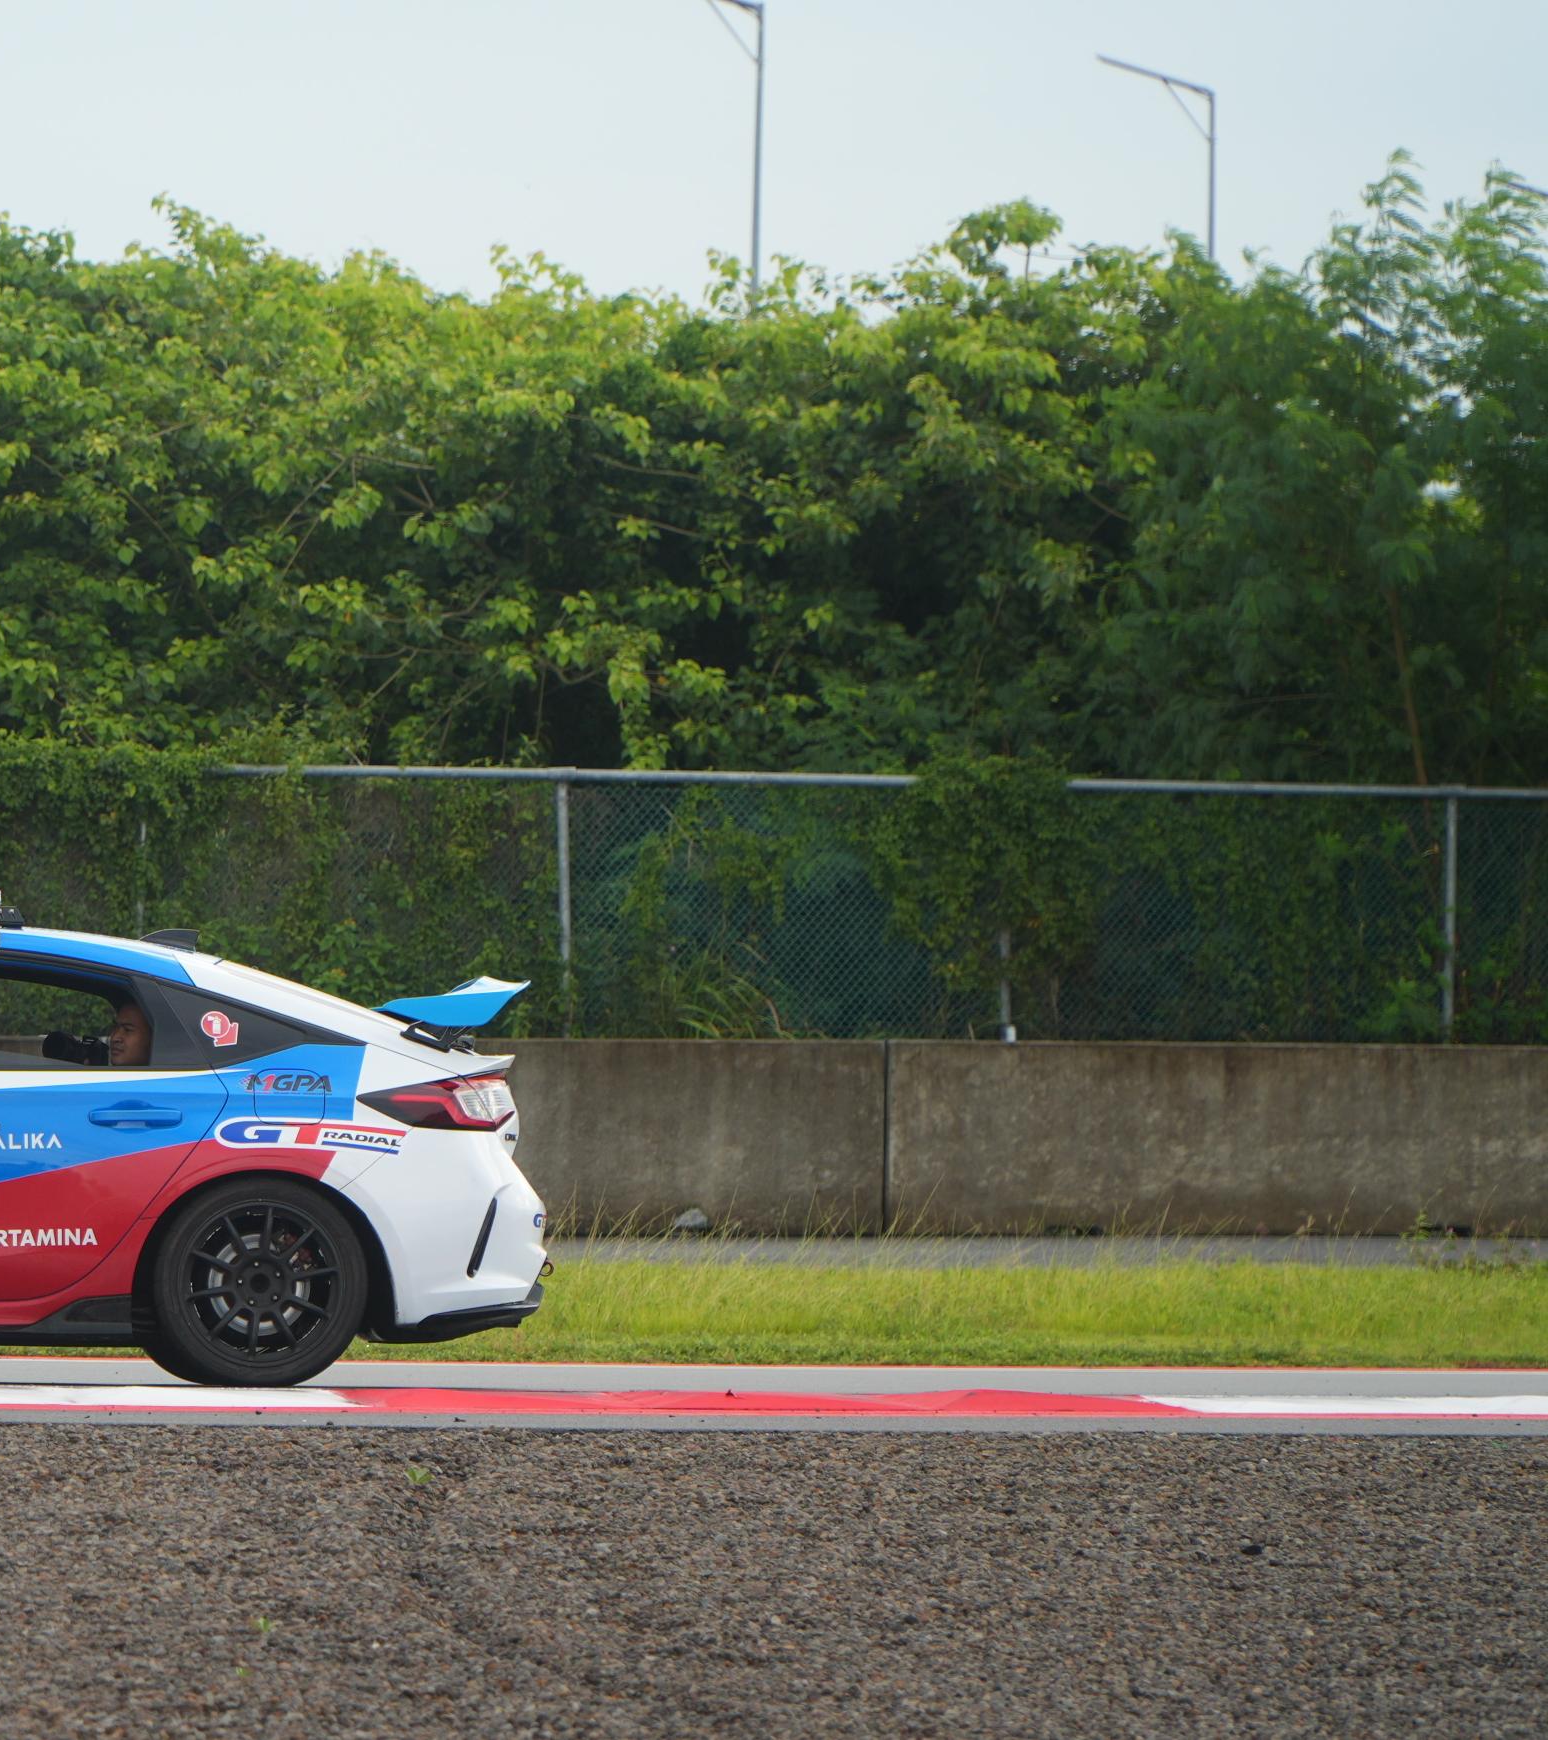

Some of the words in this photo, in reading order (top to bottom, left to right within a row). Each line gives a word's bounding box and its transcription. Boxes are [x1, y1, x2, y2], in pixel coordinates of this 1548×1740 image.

[245, 1074, 332, 1092] MGPA
[219, 1120, 323, 1145] GT
[323, 1130, 401, 1148] RADIAL
